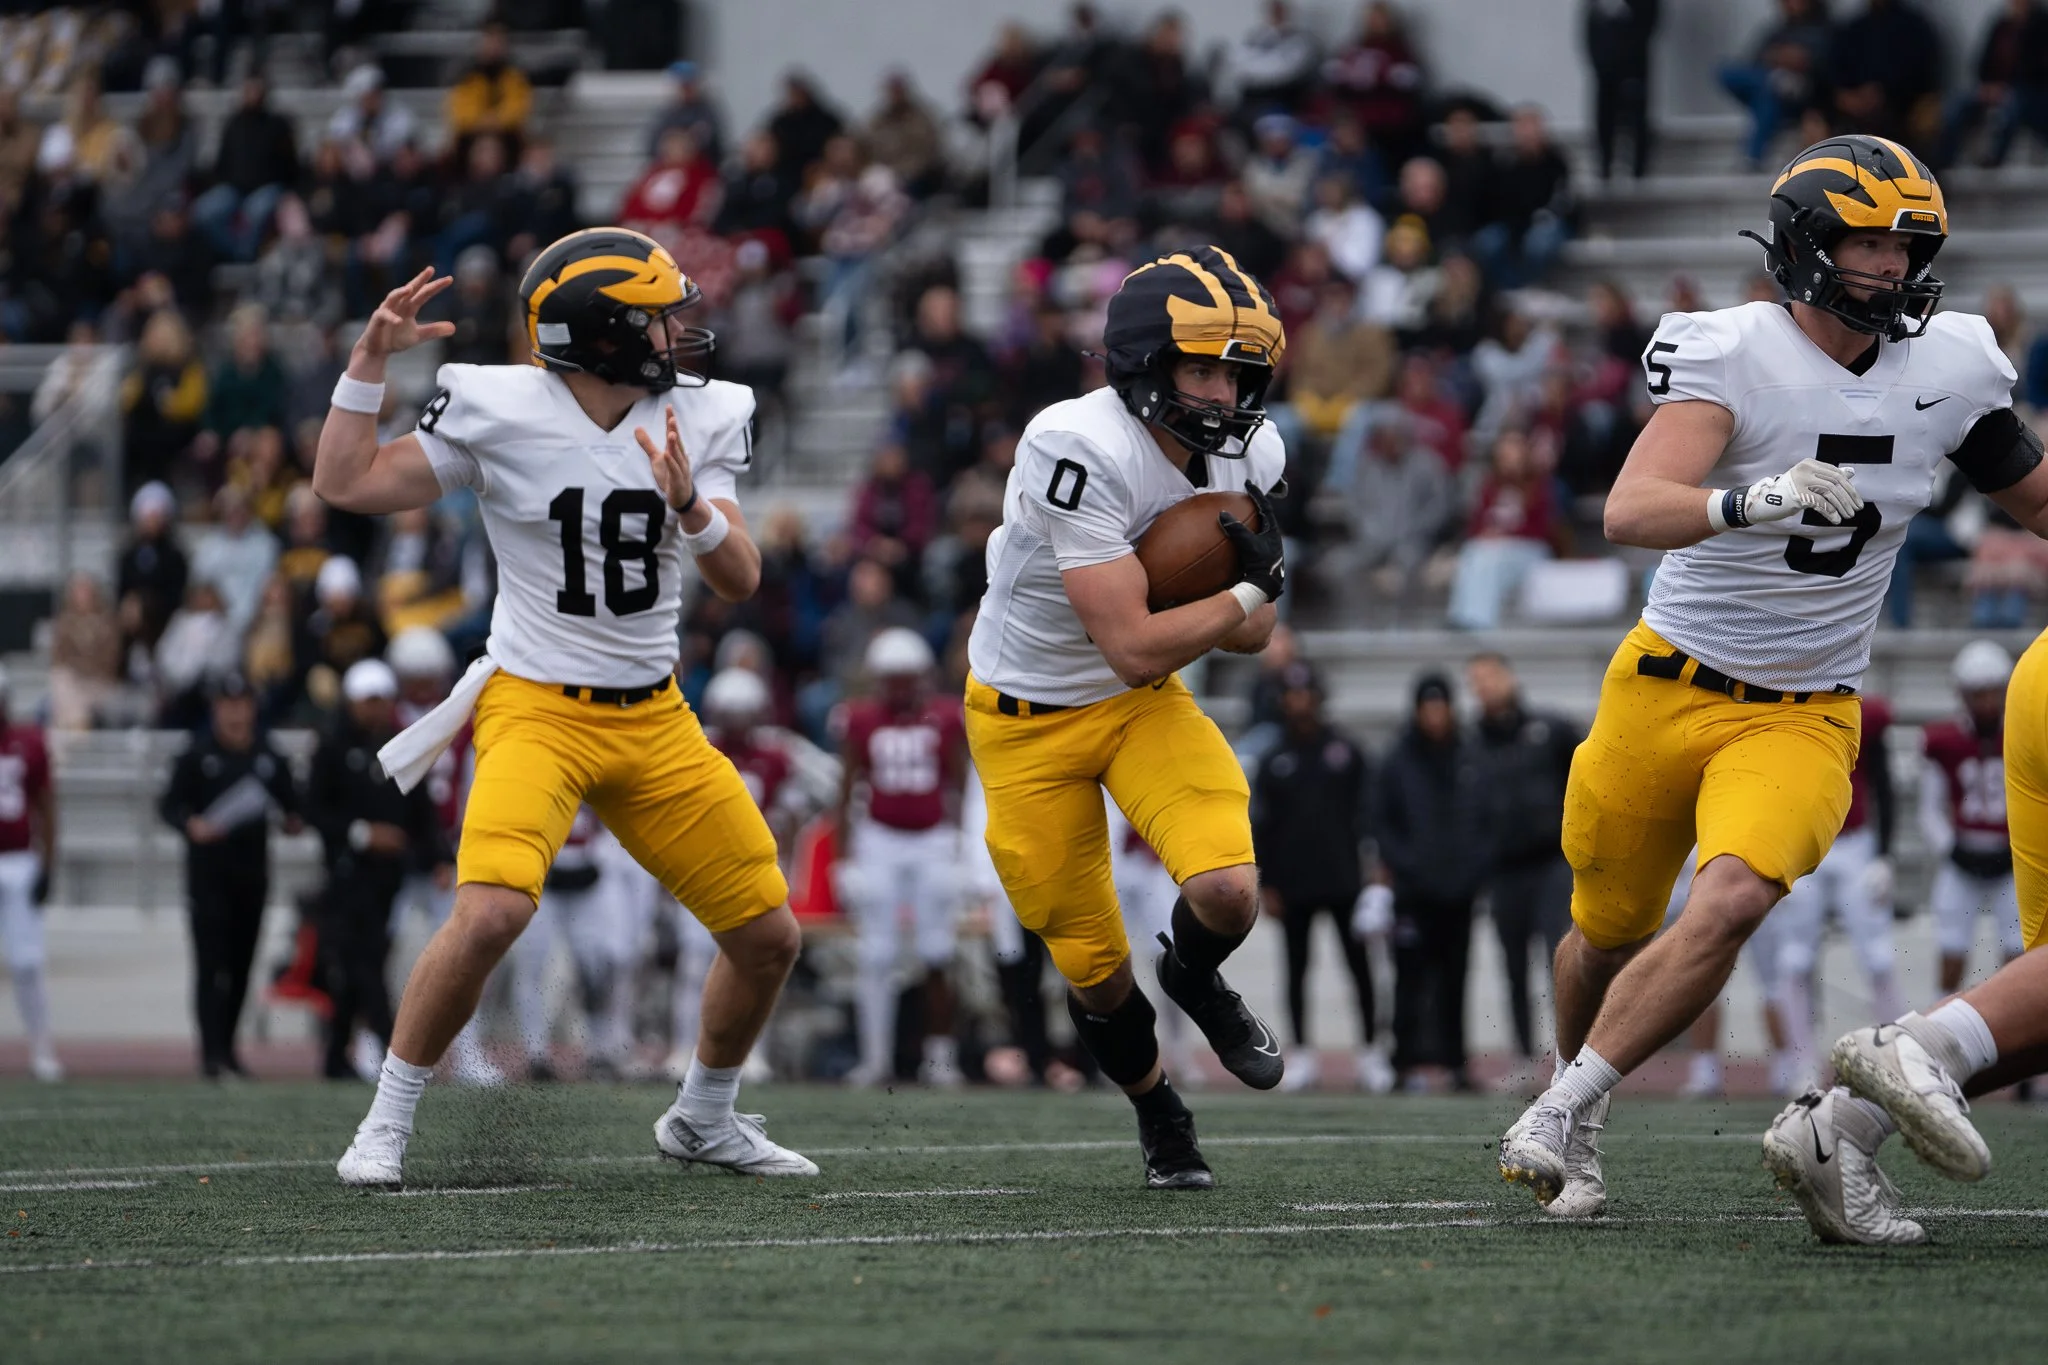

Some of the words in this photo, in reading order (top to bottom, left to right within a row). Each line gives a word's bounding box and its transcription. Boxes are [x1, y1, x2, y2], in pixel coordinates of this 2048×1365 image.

[1646, 341, 1679, 395] 5
[1046, 457, 1088, 511] 0
[1783, 433, 1895, 579] 5
[548, 487, 666, 617] 18
